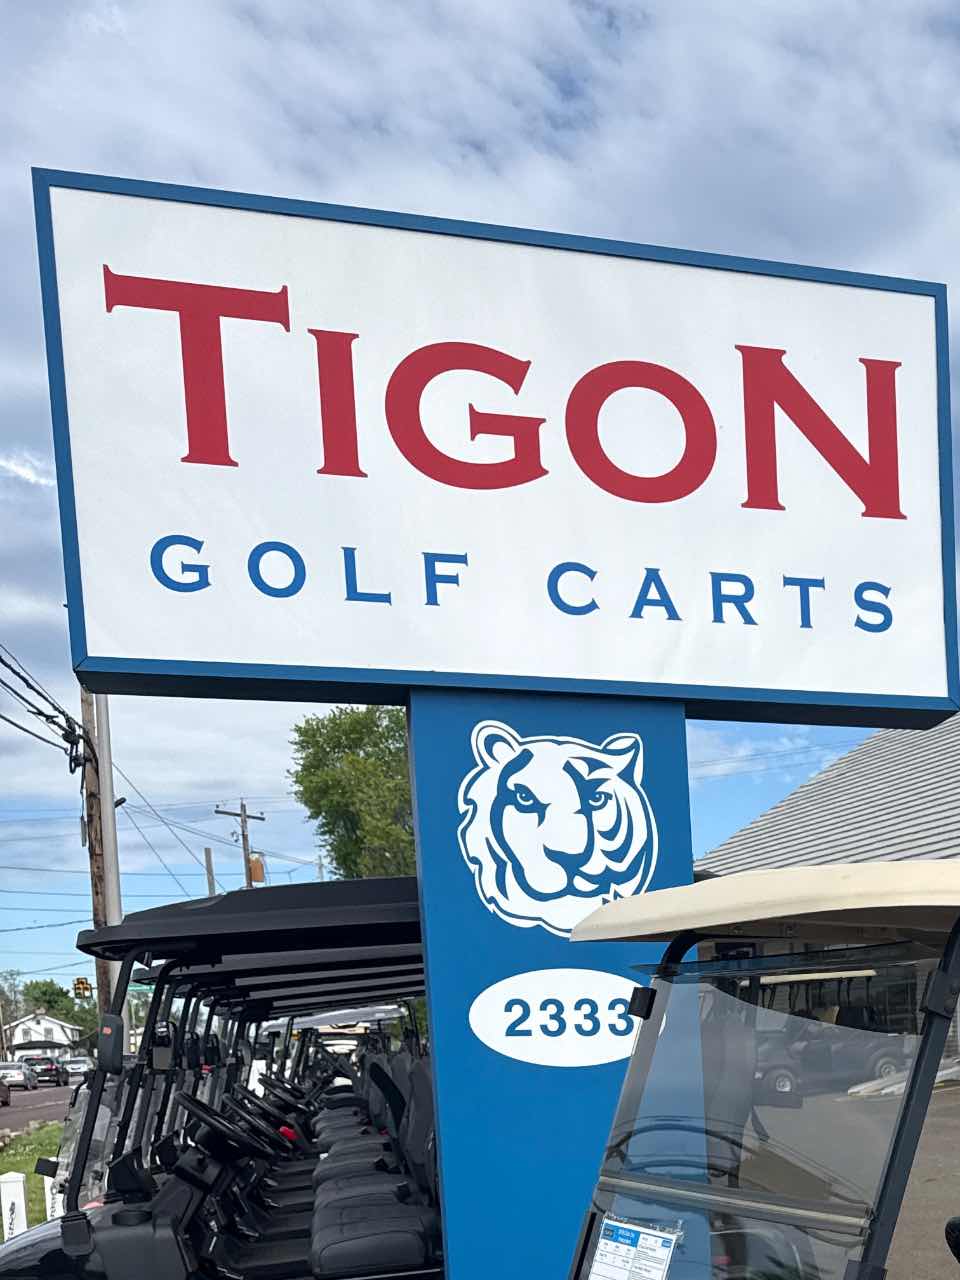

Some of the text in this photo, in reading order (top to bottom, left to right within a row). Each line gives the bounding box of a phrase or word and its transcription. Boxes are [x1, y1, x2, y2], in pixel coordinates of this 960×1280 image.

[103, 264, 907, 520] TIGON
[149, 534, 893, 633] GOLF CARTS
[504, 998, 635, 1037] 2333
